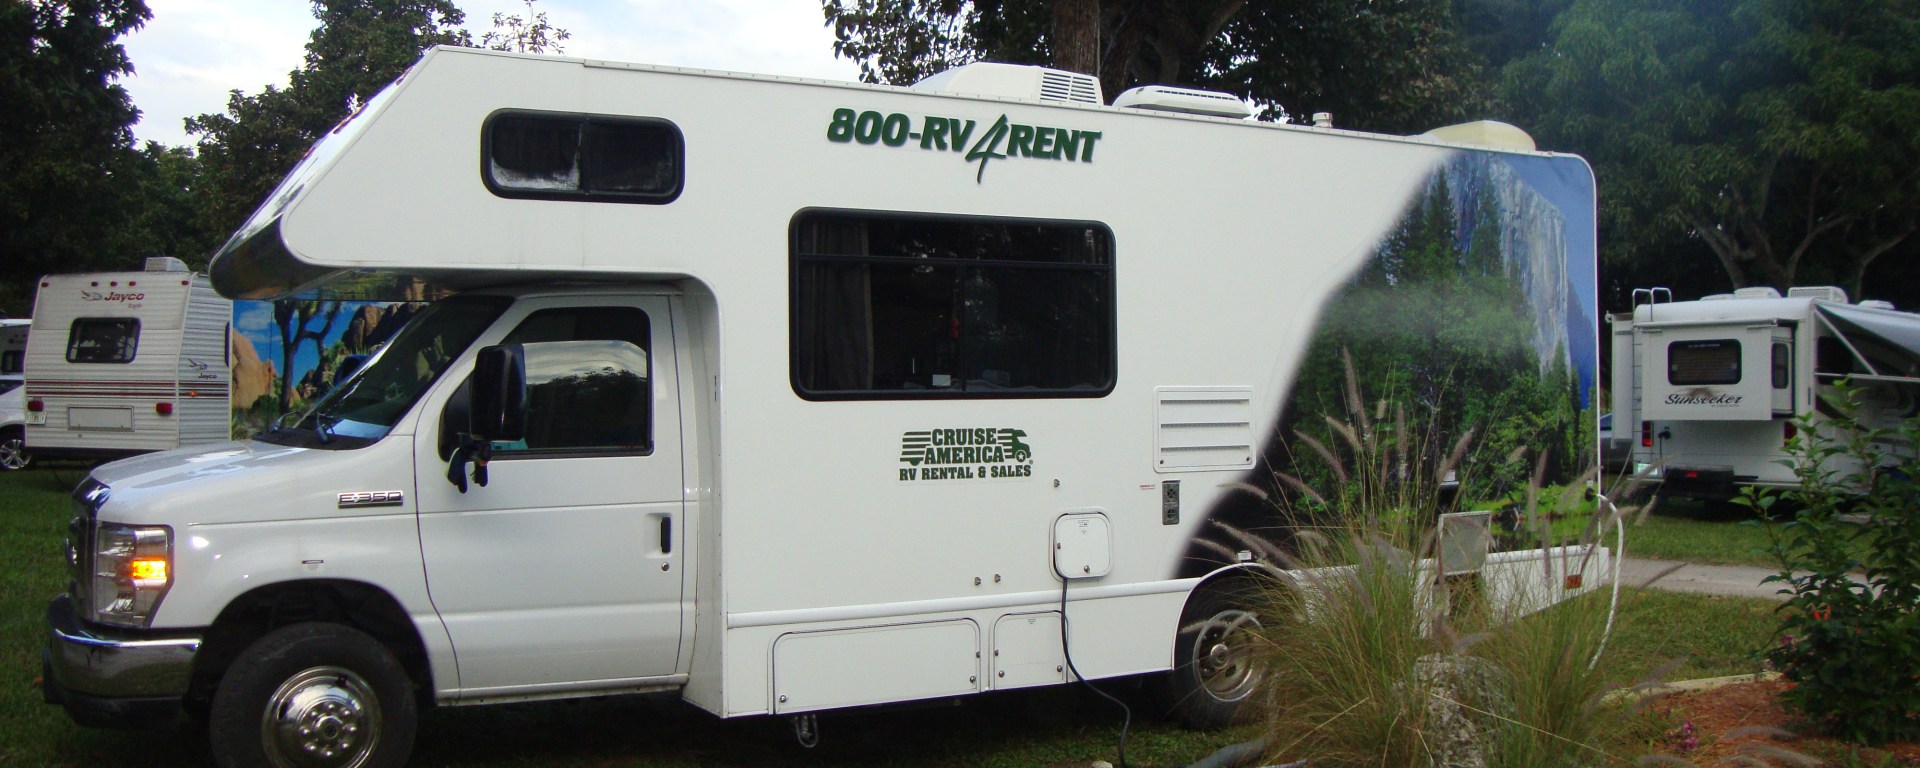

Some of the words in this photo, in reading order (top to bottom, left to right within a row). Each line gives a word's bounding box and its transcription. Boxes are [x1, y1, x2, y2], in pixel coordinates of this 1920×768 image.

[104, 292, 145, 303] Jayco
[1665, 393, 1744, 406] Sunseeker
[932, 428, 997, 446] CRUISE
[924, 446, 1005, 465] AMERICA
[899, 468, 917, 481] RV
[922, 467, 973, 480] RENTAL
[978, 466, 986, 478] &
[991, 465, 1032, 478] SALES
[338, 490, 403, 506] E-350
